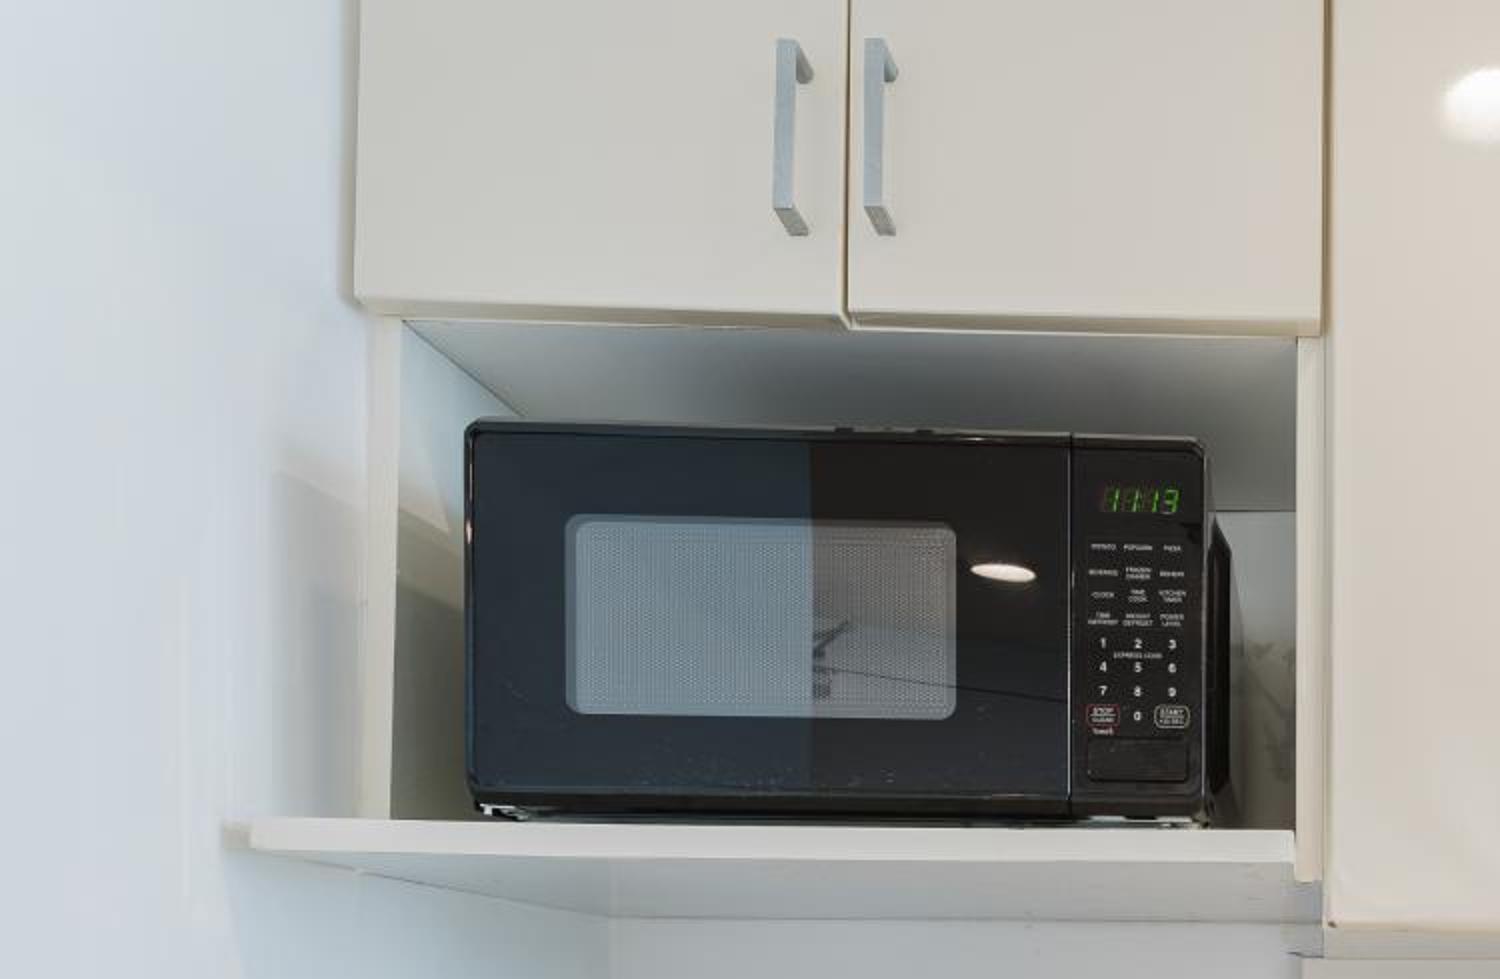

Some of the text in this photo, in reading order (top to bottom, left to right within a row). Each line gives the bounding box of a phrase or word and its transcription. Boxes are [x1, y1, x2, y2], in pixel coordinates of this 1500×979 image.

[1100, 637, 1106, 648] 1
[1134, 638, 1142, 649] 2
[1168, 639, 1177, 650] 3
[1099, 661, 1107, 672] 4
[1134, 661, 1142, 673] 5
[1168, 662, 1176, 673] 6
[1098, 685, 1107, 696] 7
[1133, 685, 1142, 697] 8
[1168, 686, 1176, 697] 9
[1133, 710, 1141, 721] 0
